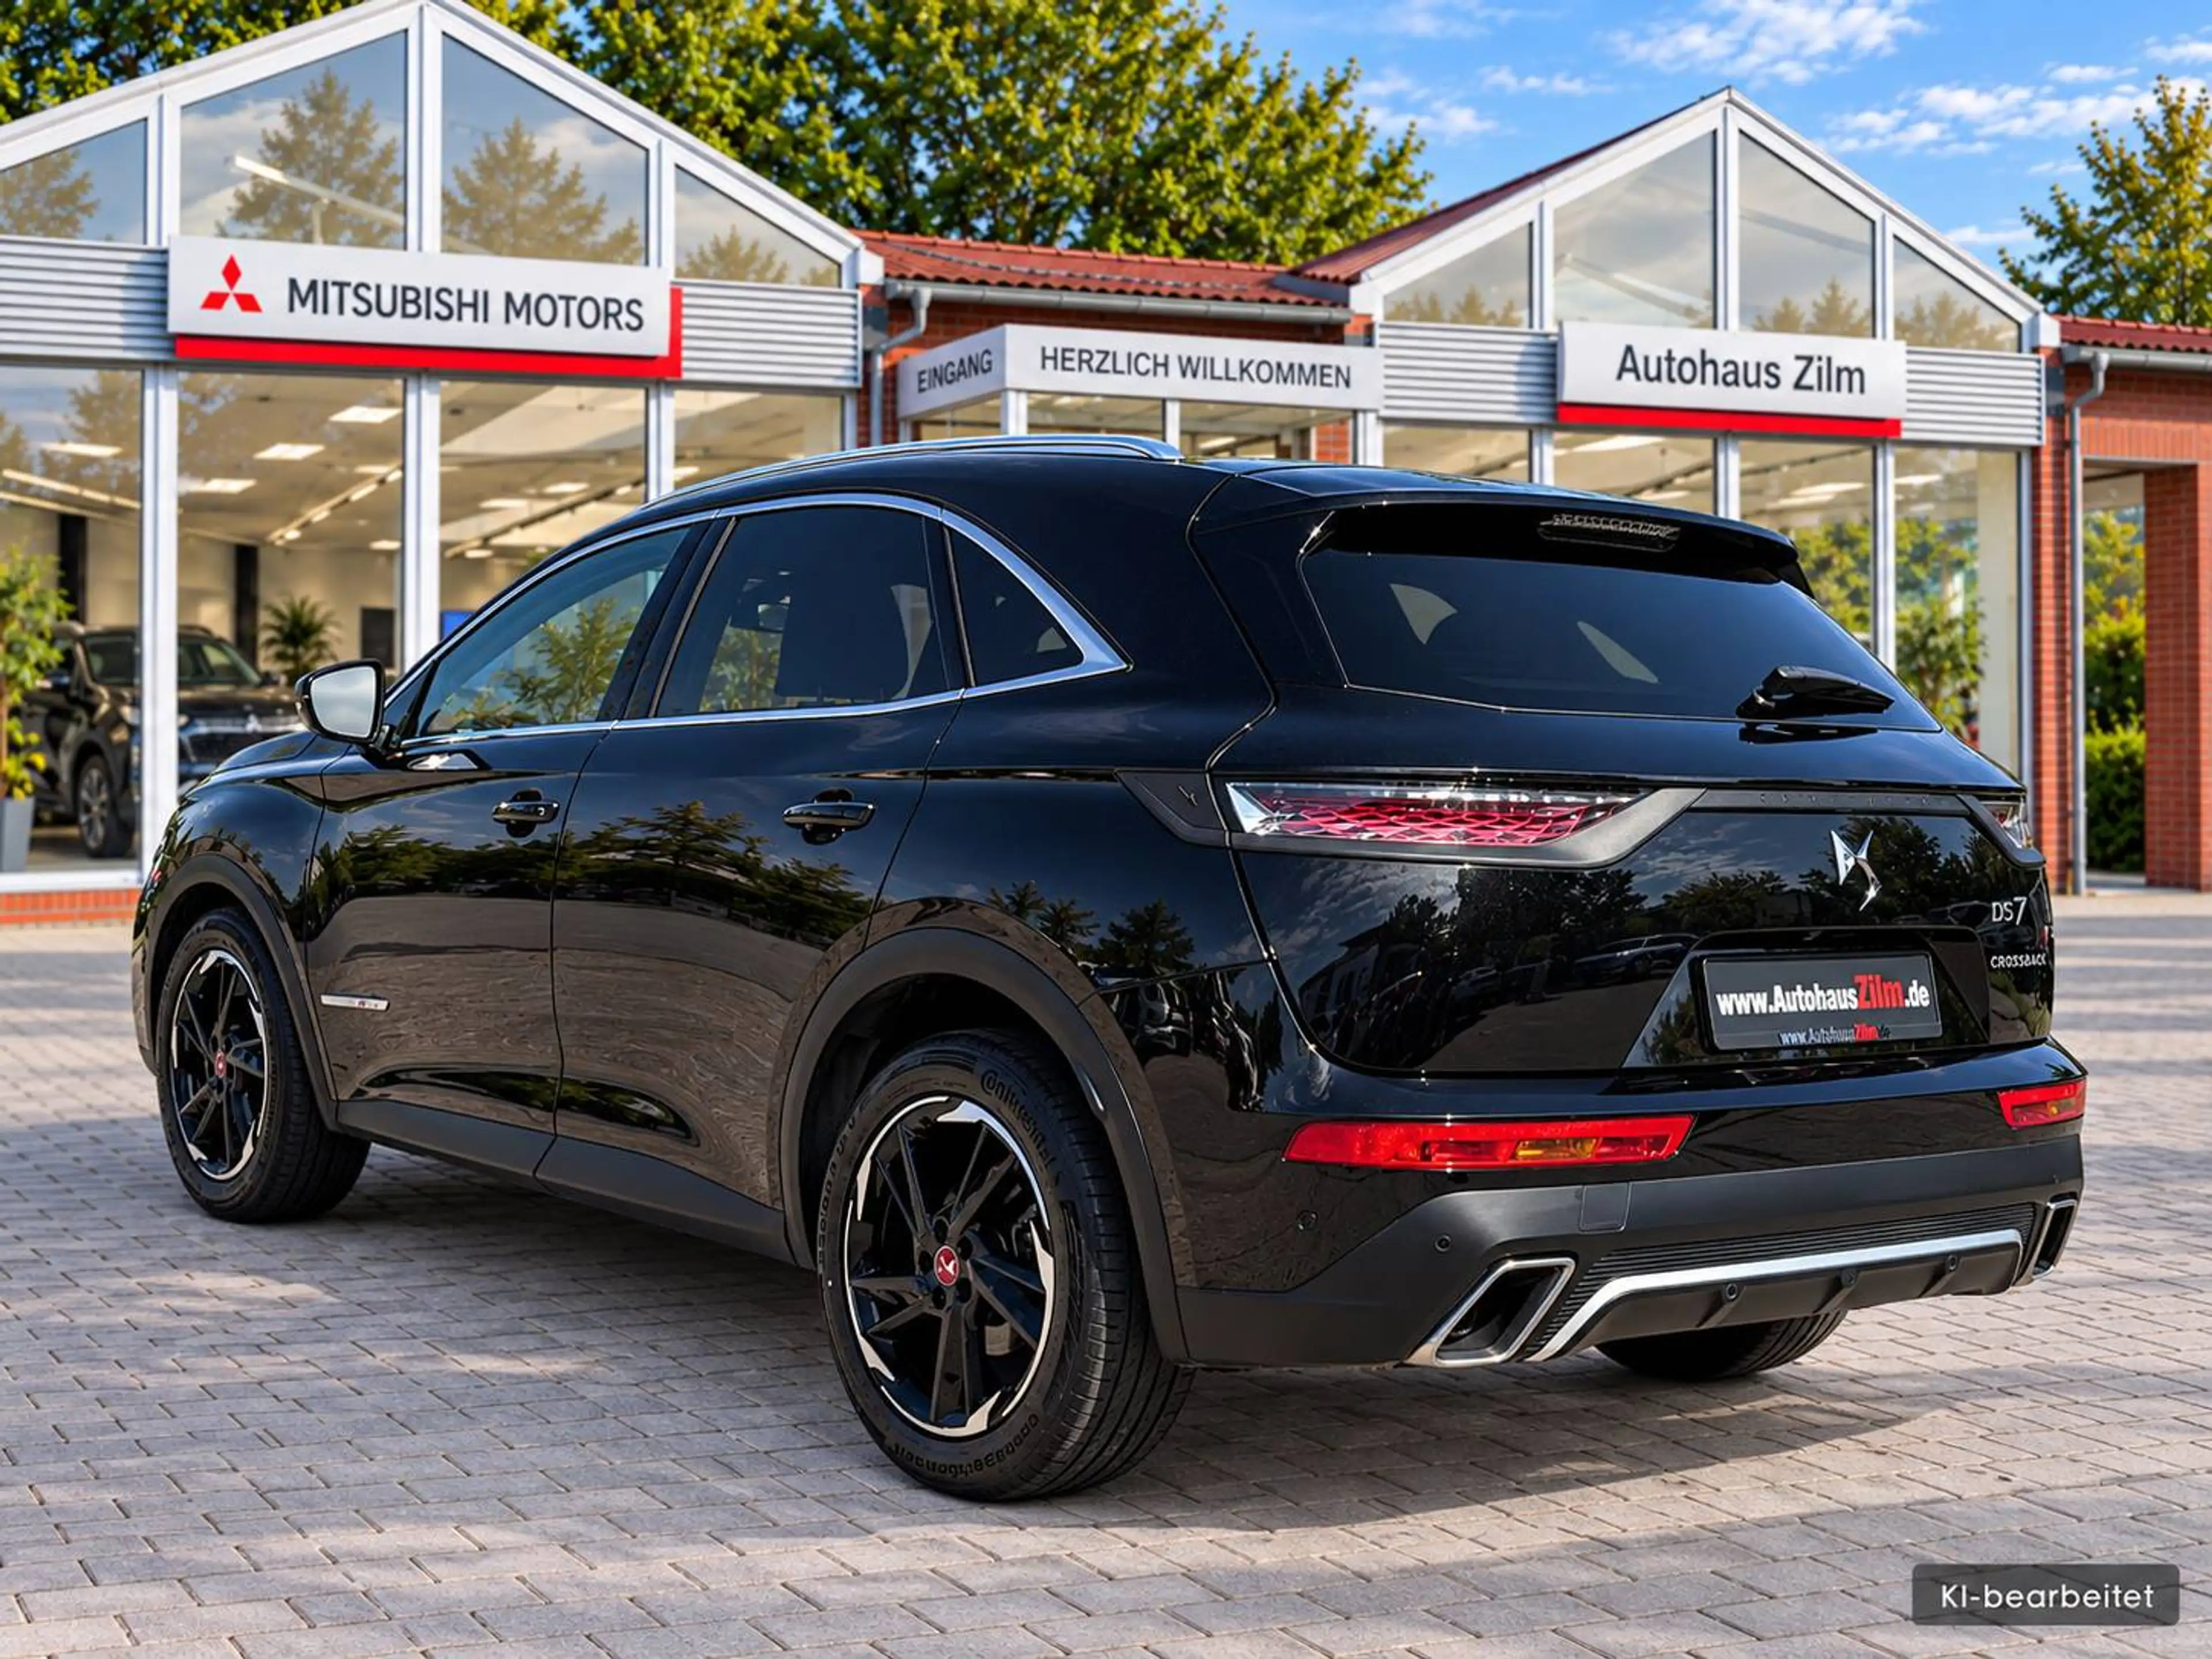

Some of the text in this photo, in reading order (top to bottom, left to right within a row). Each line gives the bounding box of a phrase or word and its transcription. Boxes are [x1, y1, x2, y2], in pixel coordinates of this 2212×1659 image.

[287, 277, 644, 332] MITSUBISHI MOTORS
[917, 349, 993, 393] EINGANG
[1040, 346, 1351, 389] HERZLICH WILLKOMMEN
[1616, 344, 1865, 394] Autohaus Zilm
[1990, 953, 2046, 968] CROSSBACK
[1715, 974, 1930, 1016] www.AutohausZilm.de
